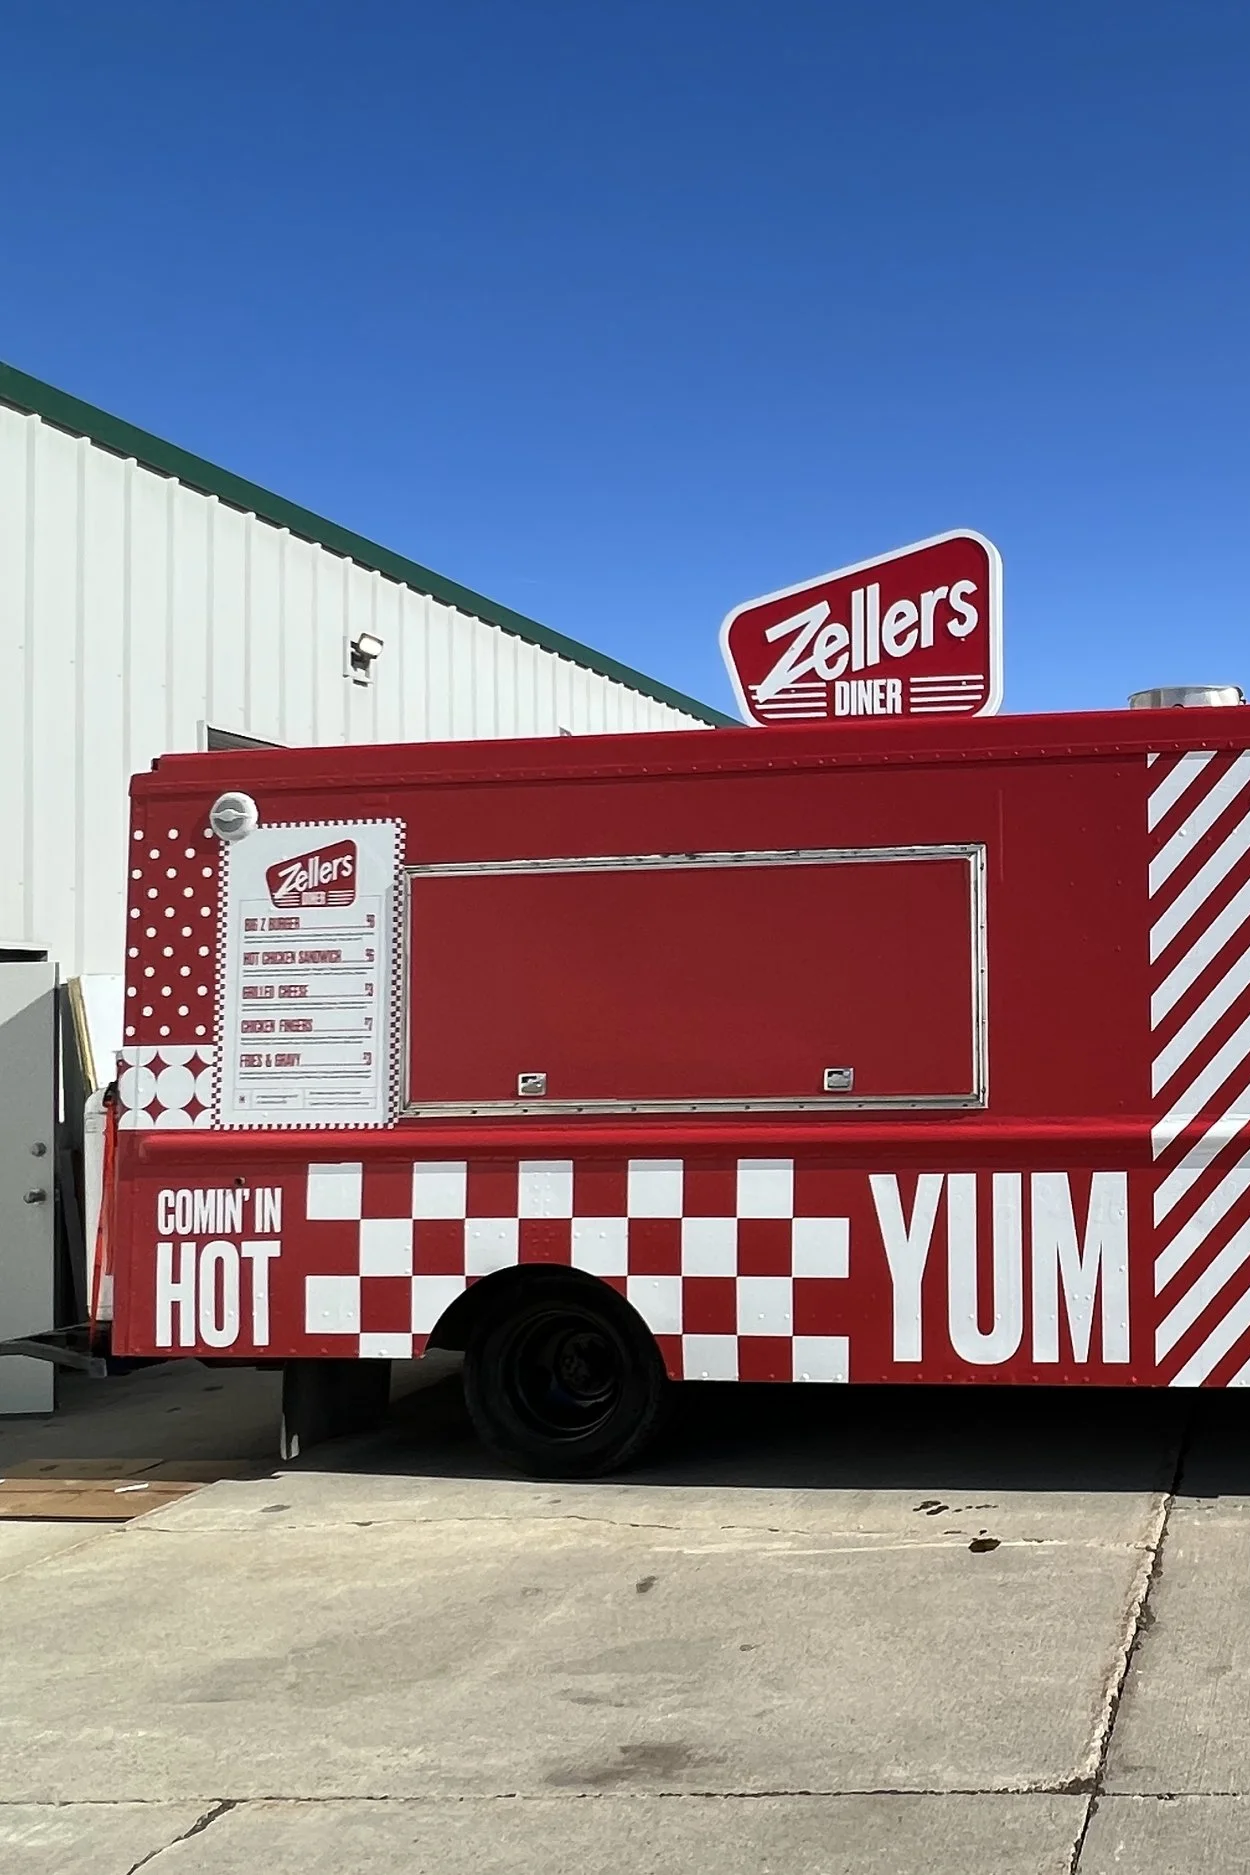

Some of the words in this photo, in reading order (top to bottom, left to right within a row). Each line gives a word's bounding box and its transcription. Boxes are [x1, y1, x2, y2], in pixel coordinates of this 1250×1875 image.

[756, 579, 979, 704] Zellers
[835, 678, 902, 716] DINER
[274, 855, 353, 899] Zellers
[157, 1187, 250, 1235] COMIN'
[254, 1187, 282, 1233] IN
[155, 1240, 281, 1347] HOT
[868, 1171, 1131, 1365] YUM
